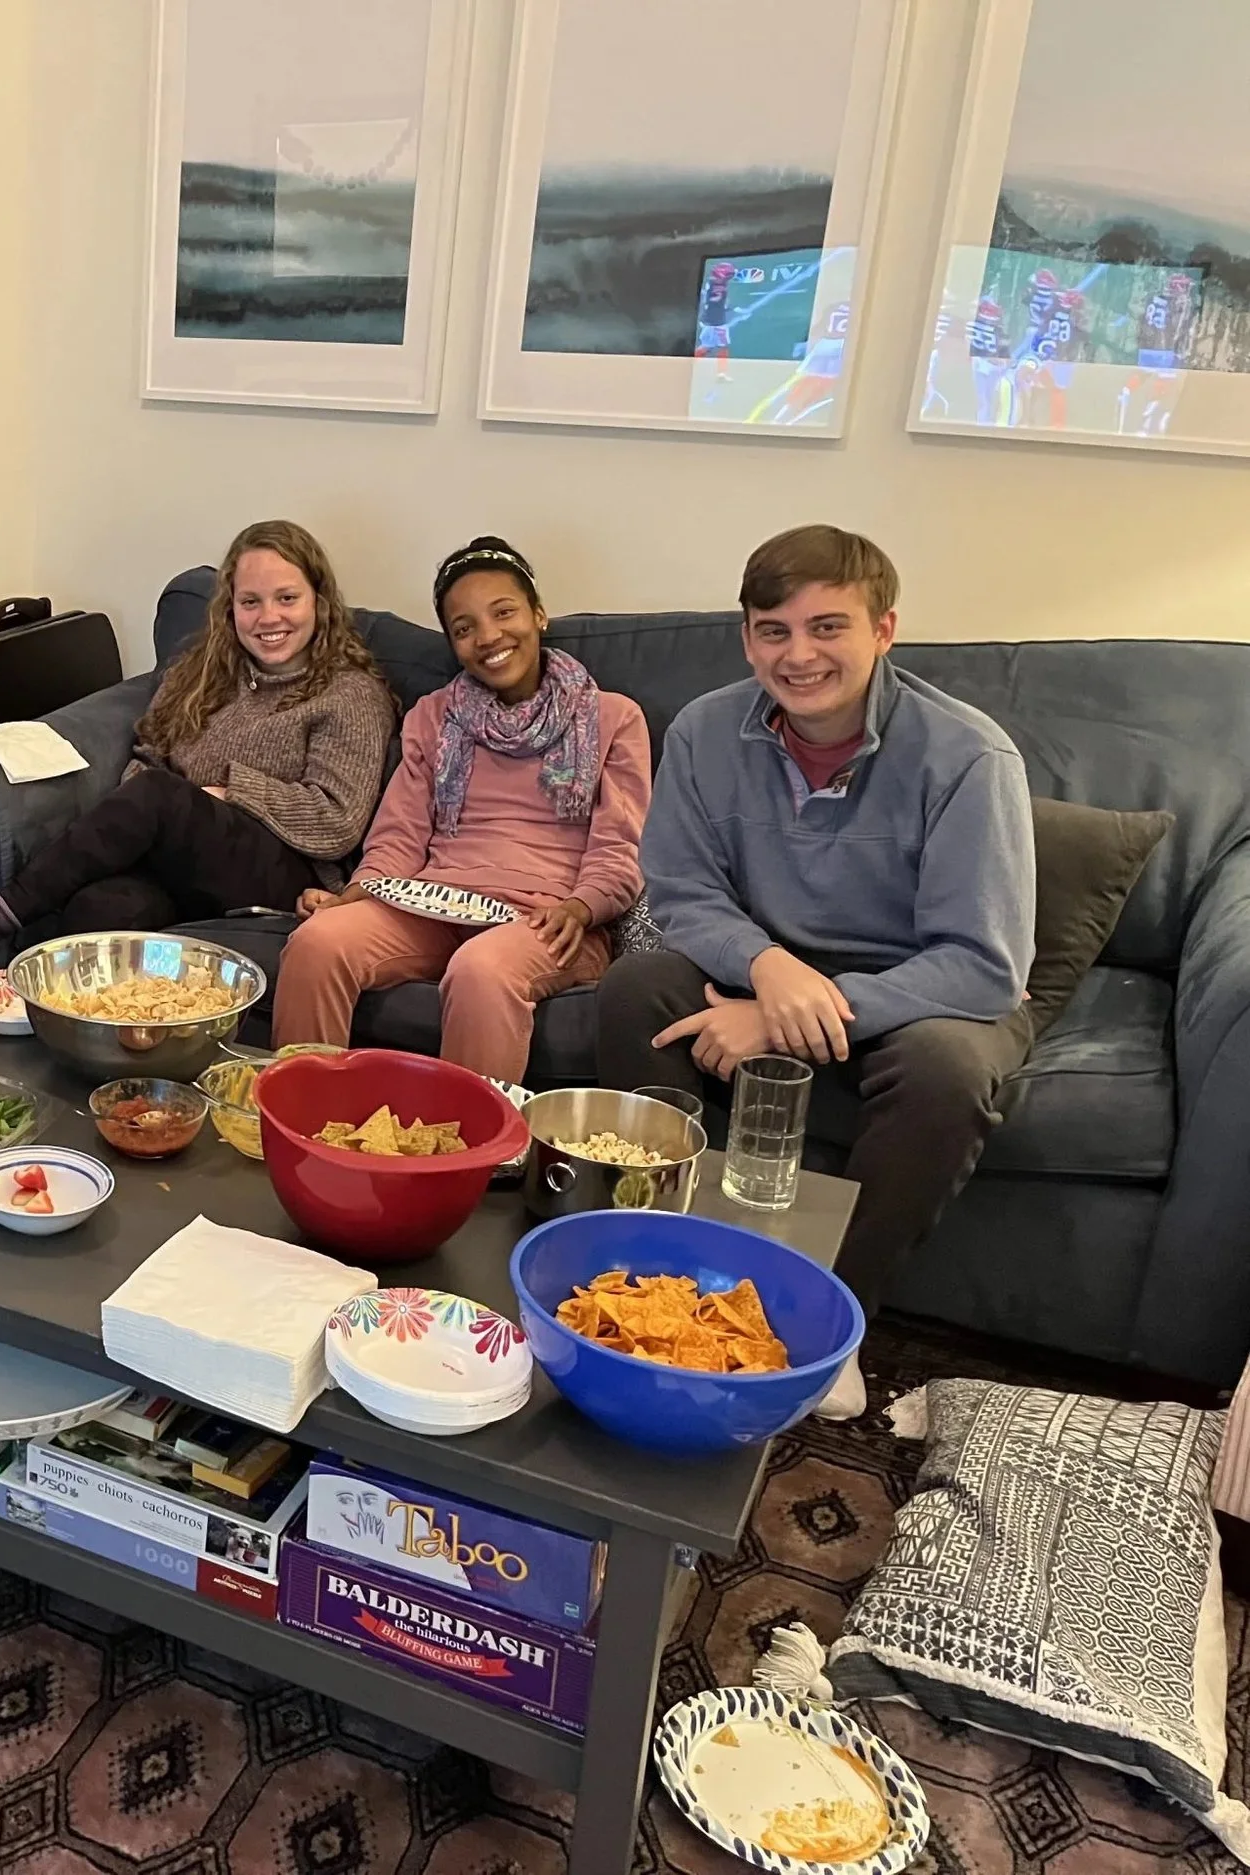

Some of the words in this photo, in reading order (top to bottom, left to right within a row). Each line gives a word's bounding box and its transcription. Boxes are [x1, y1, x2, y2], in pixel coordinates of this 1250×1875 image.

[39, 1474, 69, 1495] 750
[43, 1462, 89, 1486] puppies
[97, 1483, 134, 1504] chiots
[142, 1501, 203, 1531] cachorros
[135, 1542, 190, 1576] 1000
[387, 1500, 529, 1583] Taboo
[327, 1574, 546, 1668] BALDERDASH
[394, 1619, 415, 1634] the
[416, 1626, 472, 1654] hilarious
[381, 1626, 444, 1662] BLUFFING
[444, 1651, 484, 1670] GAME
